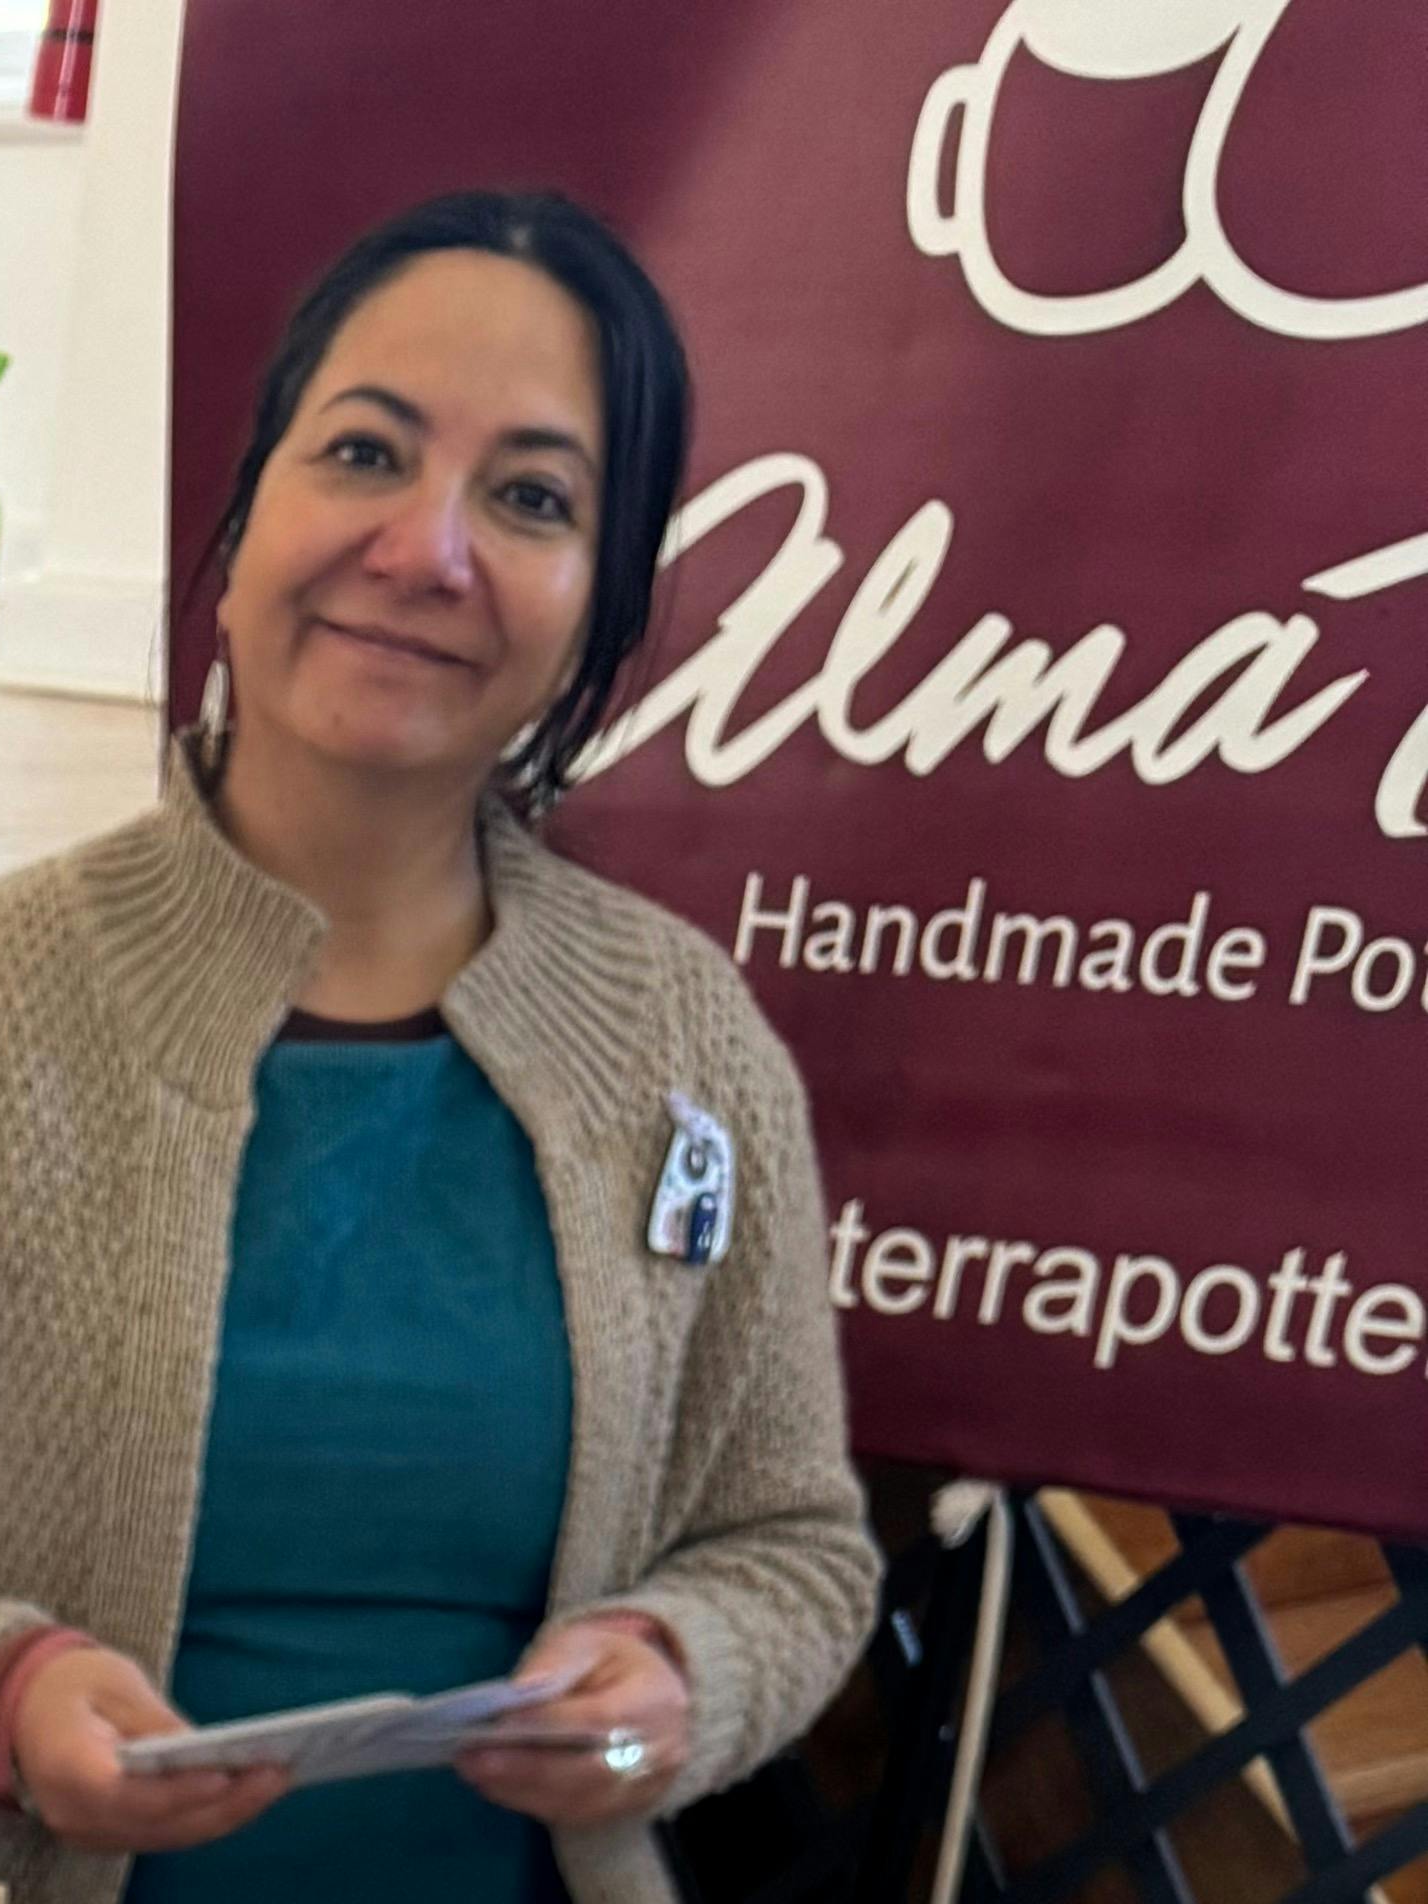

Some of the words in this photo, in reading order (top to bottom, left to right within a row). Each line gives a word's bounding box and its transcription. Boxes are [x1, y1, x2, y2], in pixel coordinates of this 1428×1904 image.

[732, 871, 1267, 1001] Handmade
[1288, 904, 1428, 1013] Po
[829, 1197, 1428, 1376] terrapotte
